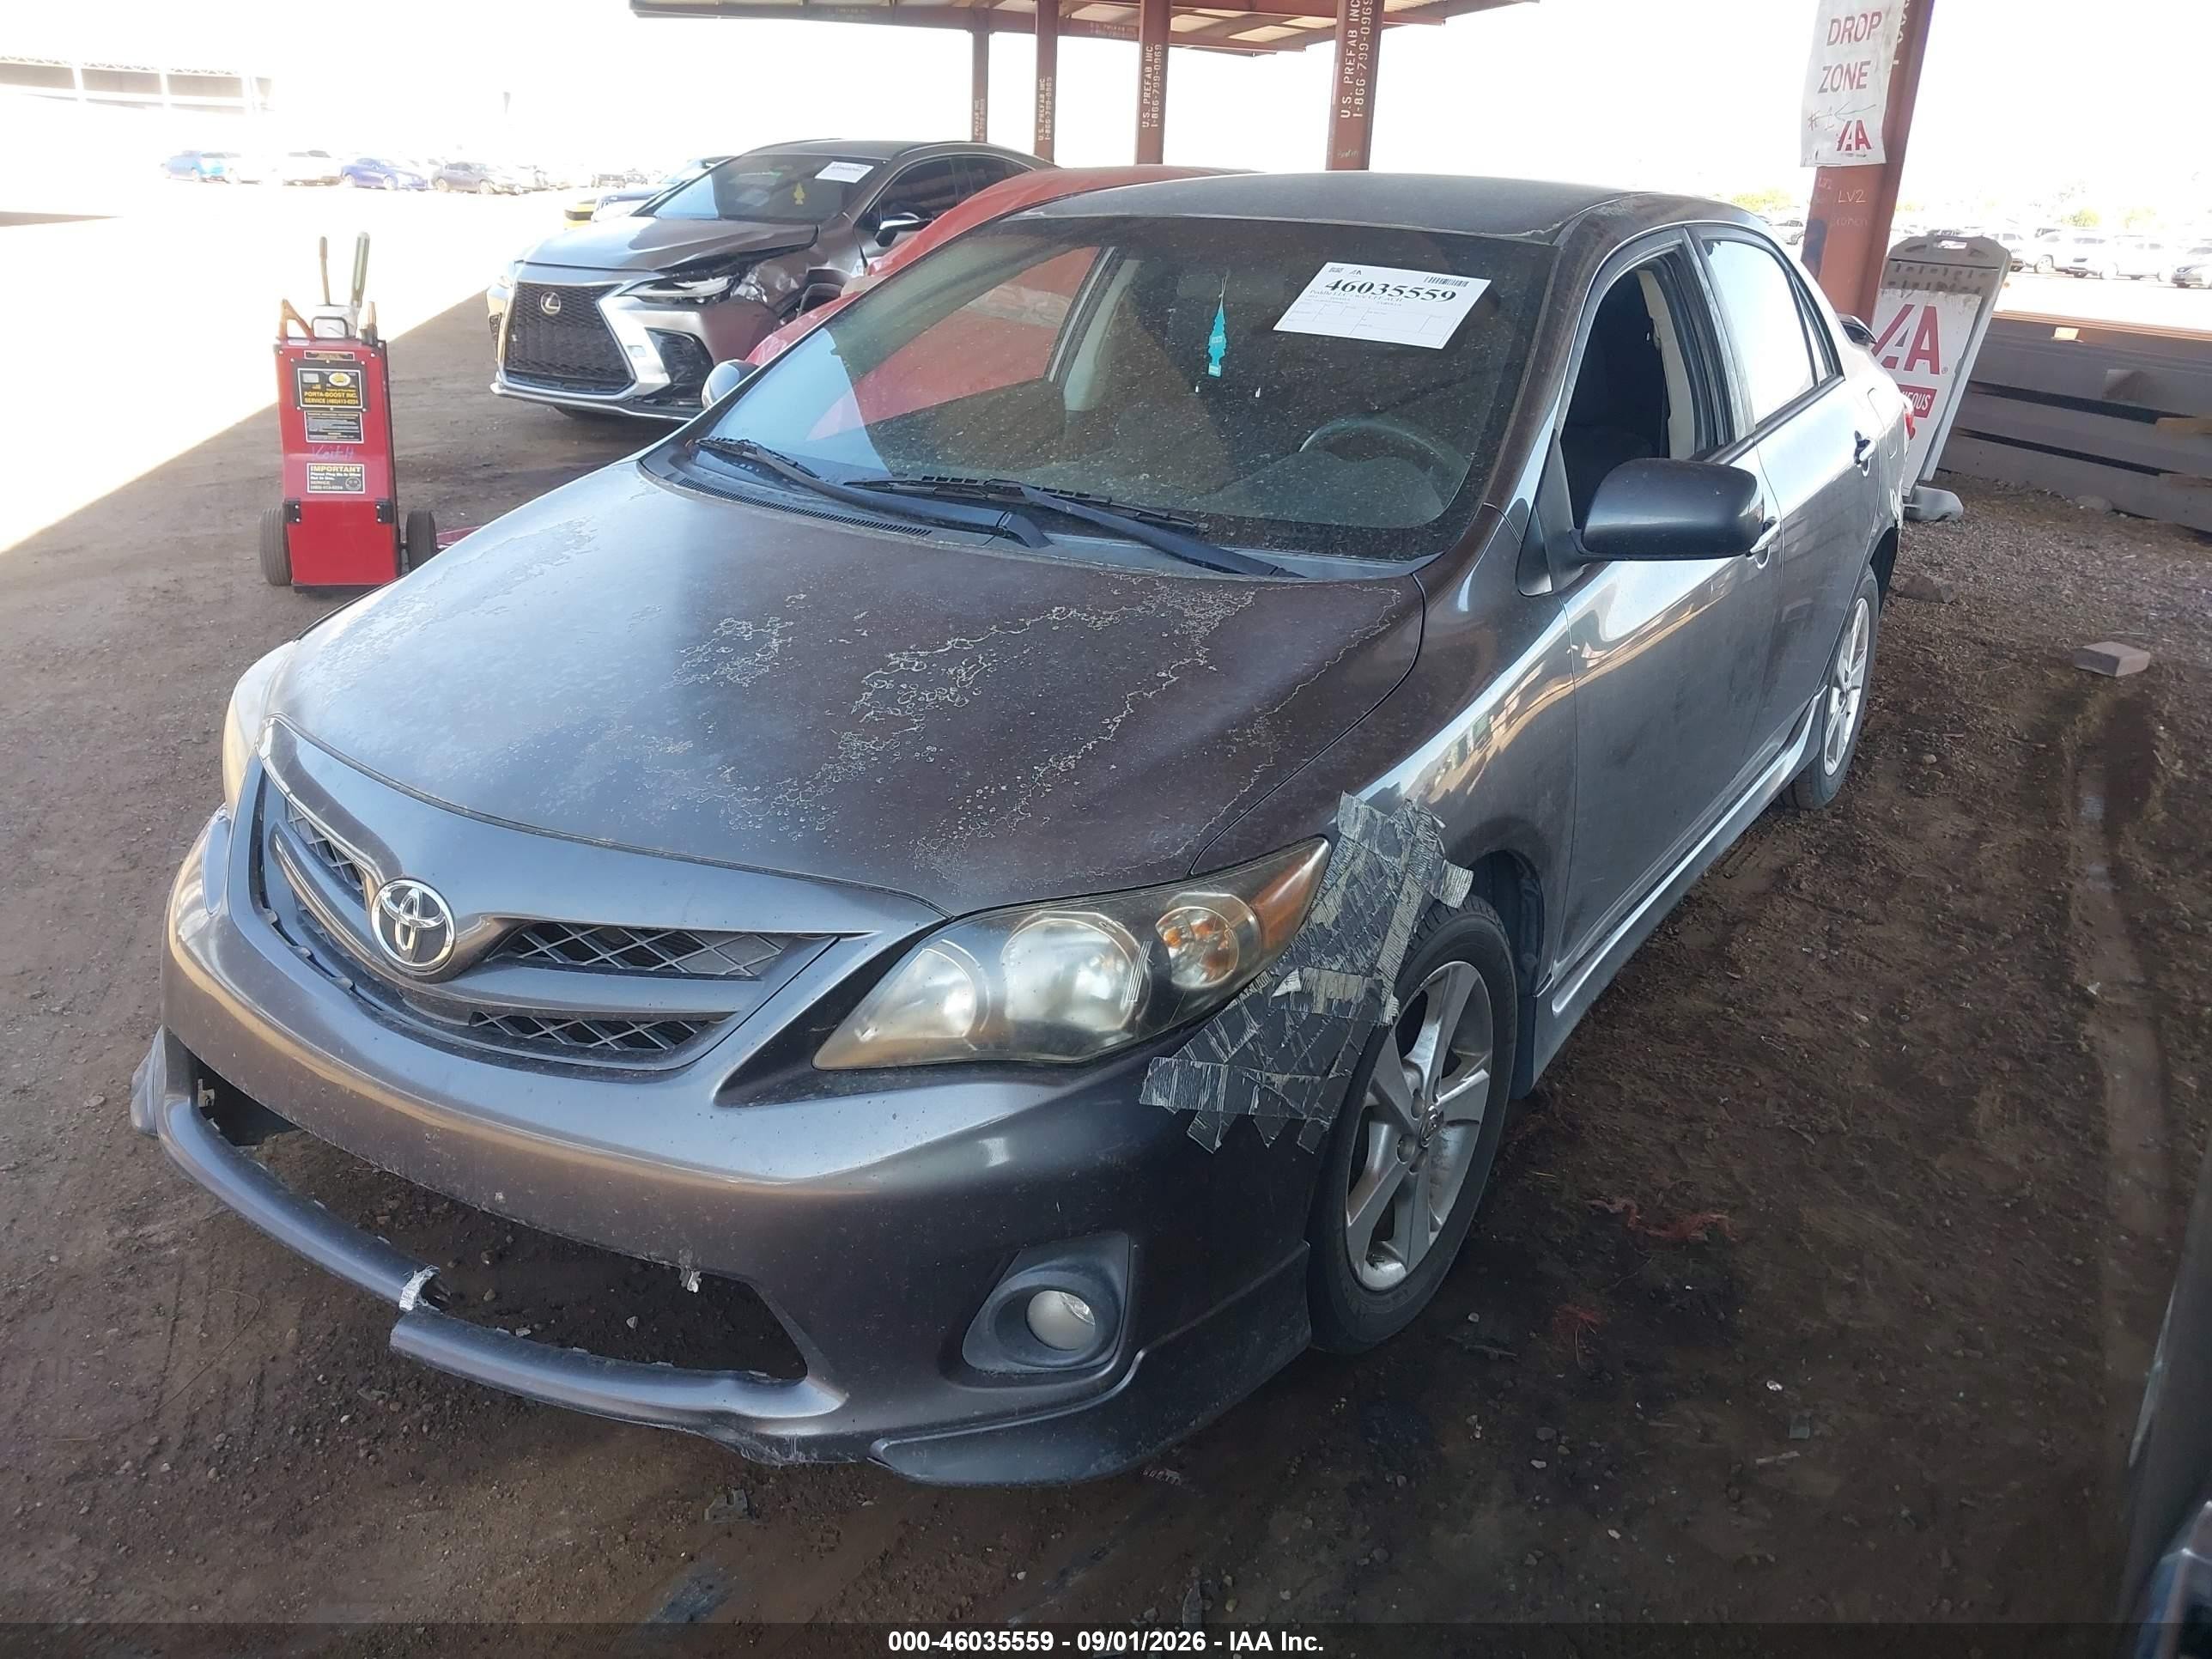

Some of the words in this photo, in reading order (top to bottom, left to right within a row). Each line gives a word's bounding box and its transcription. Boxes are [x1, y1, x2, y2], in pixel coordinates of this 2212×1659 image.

[1827, 11, 1882, 46] DROP
[1343, 29, 1358, 84] PREFAB
[1143, 66, 1152, 104] PREFAB
[1818, 61, 1871, 94] ZONE
[1340, 92, 1353, 118] U.S.
[1325, 278, 1457, 302] 46035559
